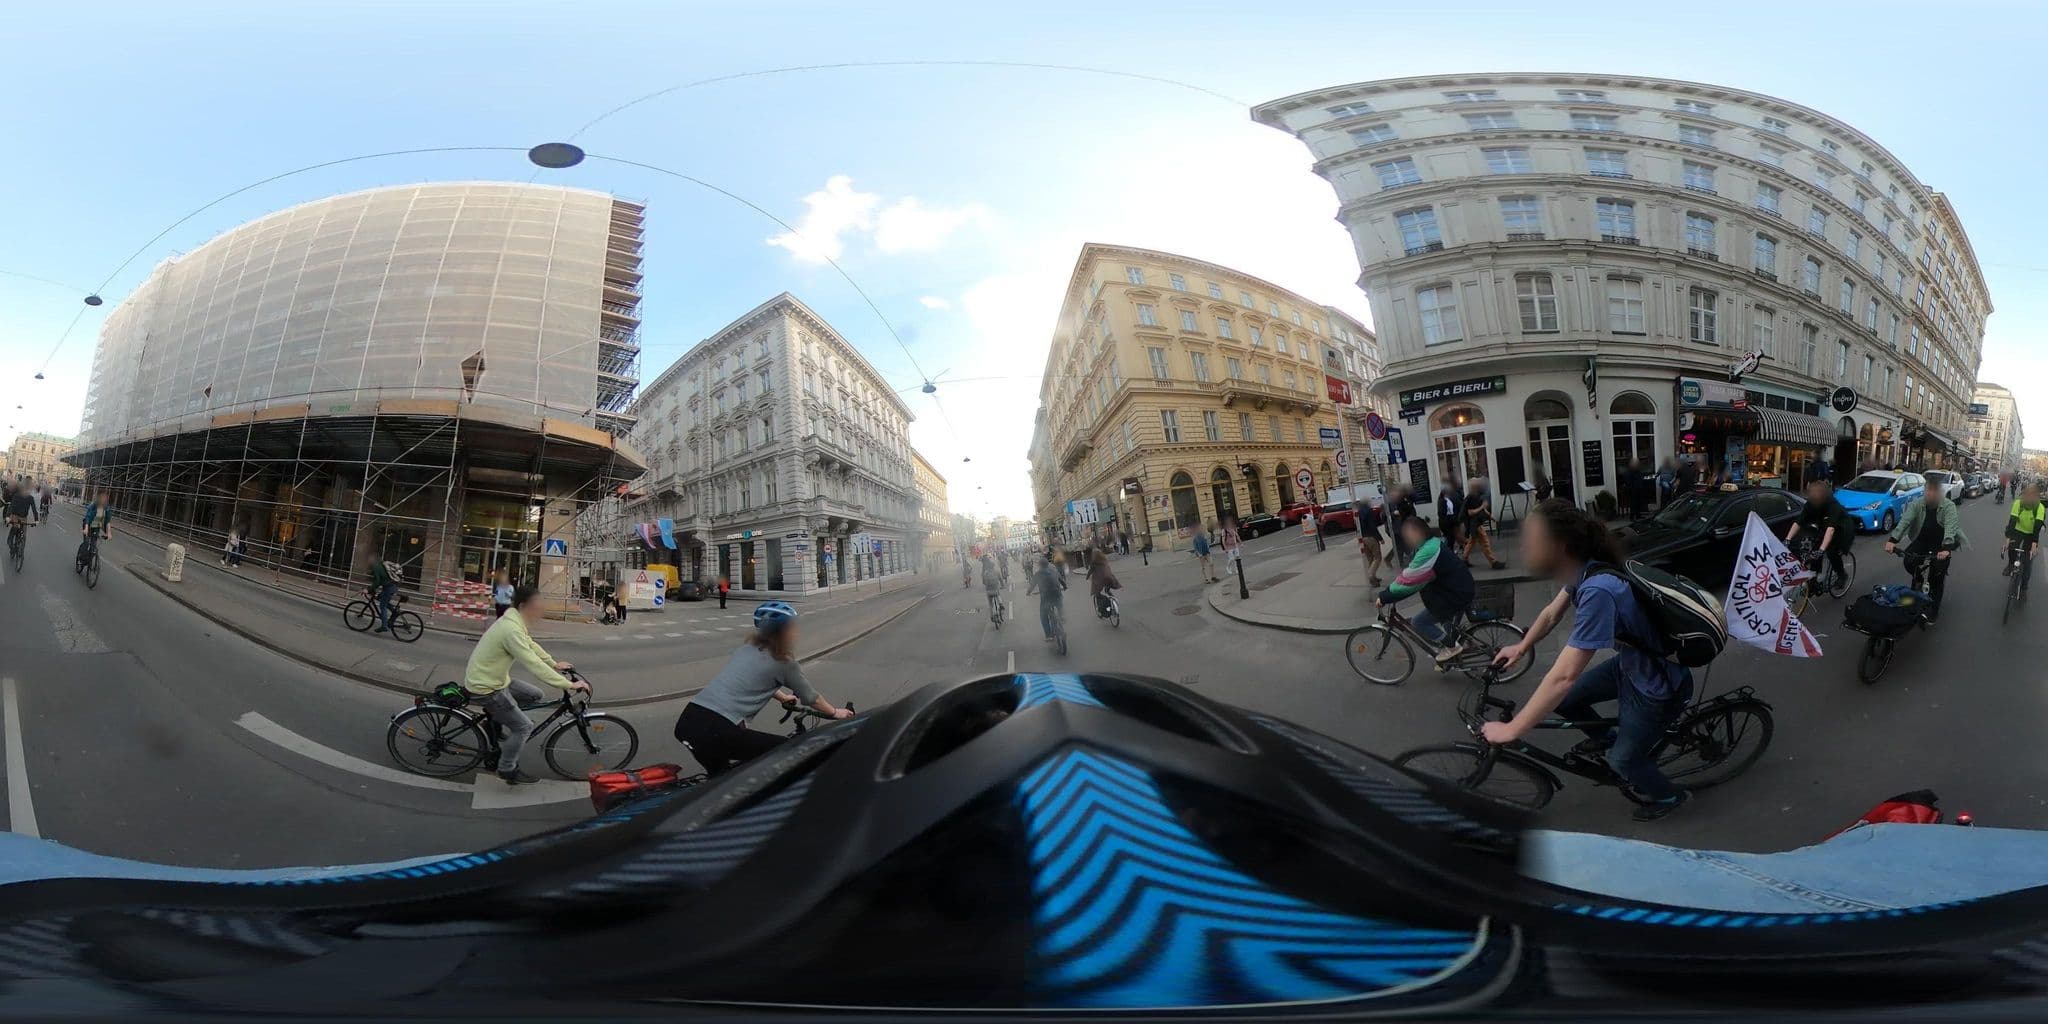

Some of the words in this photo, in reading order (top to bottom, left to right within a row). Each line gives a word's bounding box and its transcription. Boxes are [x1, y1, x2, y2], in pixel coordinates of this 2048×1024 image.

[1413, 389, 1441, 401] BIER
[1443, 387, 1451, 396] &
[1453, 382, 1492, 395] BIERLI
[1732, 573, 1771, 635] CRITICAL
